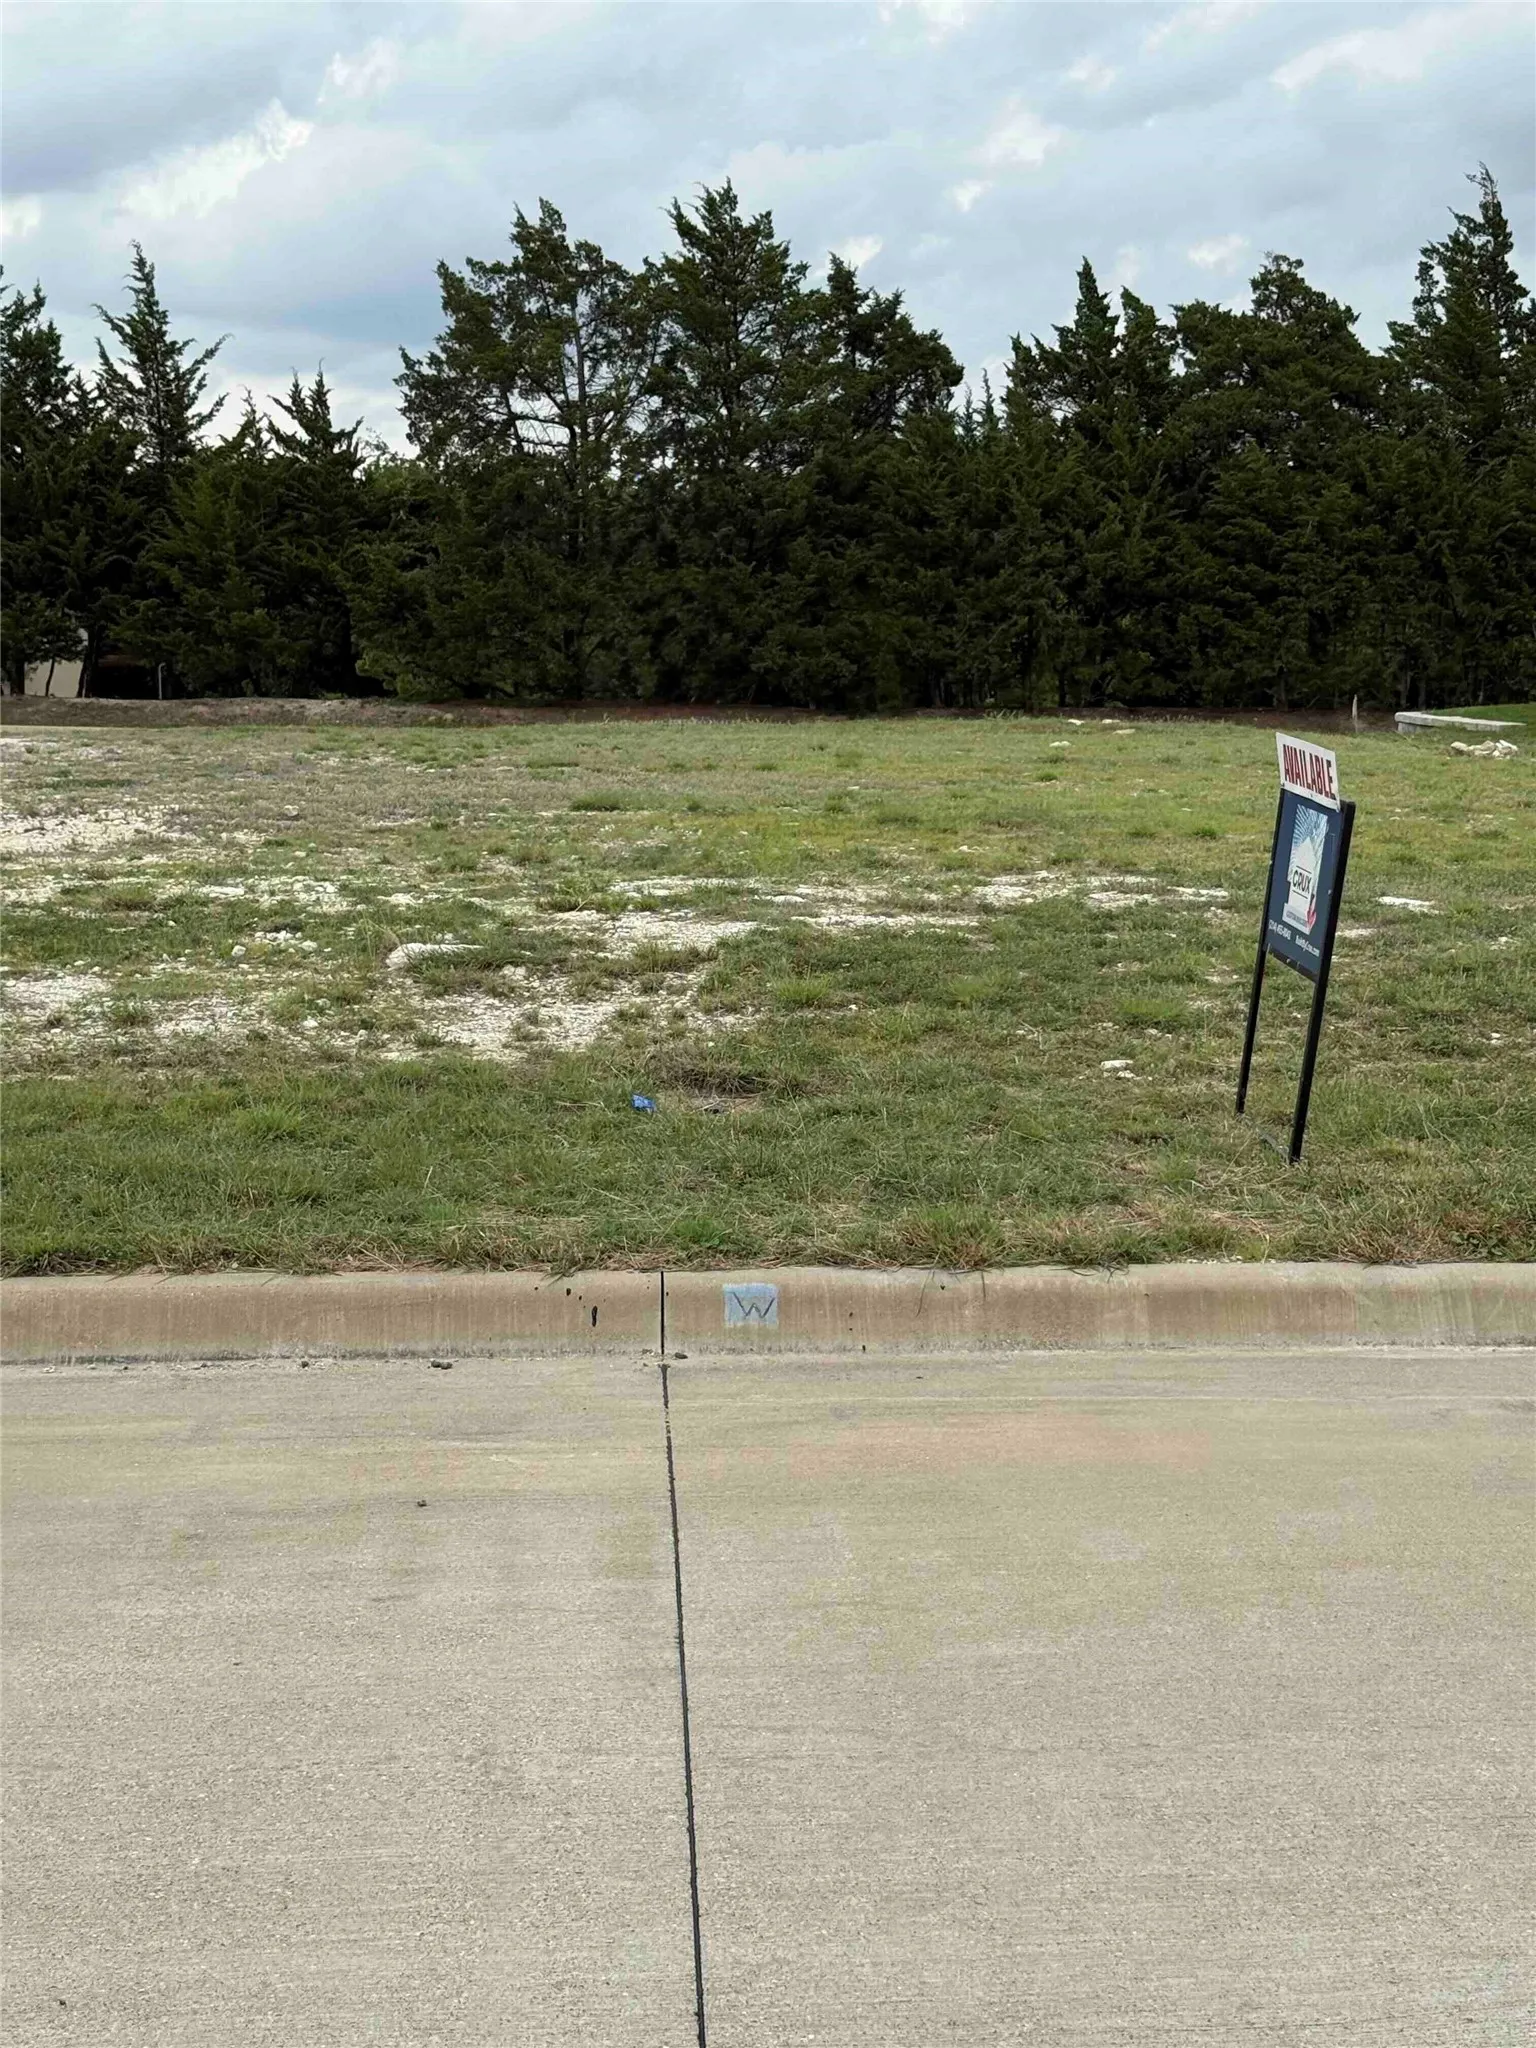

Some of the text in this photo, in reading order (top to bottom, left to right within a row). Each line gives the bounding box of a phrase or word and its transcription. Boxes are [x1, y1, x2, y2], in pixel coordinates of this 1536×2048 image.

[1283, 744, 1337, 800] AVAILABLE
[1292, 870, 1312, 894] CRUX
[728, 1291, 777, 1319] W
